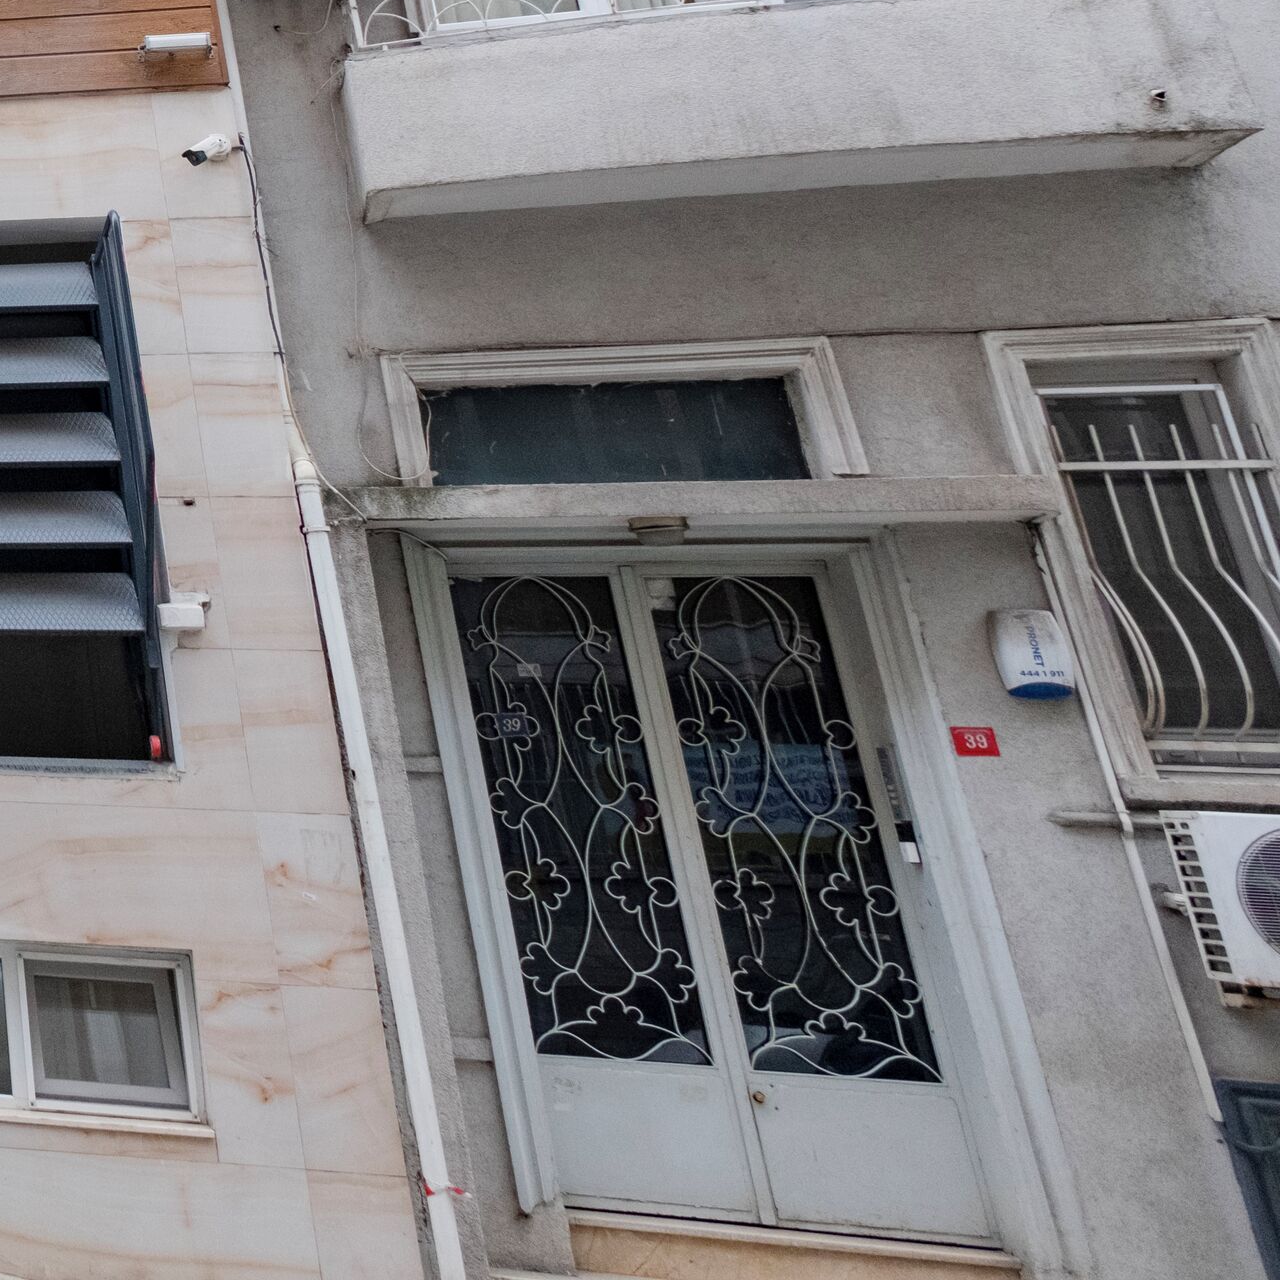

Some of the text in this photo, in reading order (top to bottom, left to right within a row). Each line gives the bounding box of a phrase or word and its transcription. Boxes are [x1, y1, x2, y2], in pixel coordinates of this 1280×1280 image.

[1024, 623, 1046, 668] PRONET
[503, 718, 521, 732] 39
[964, 734, 988, 749] 39
